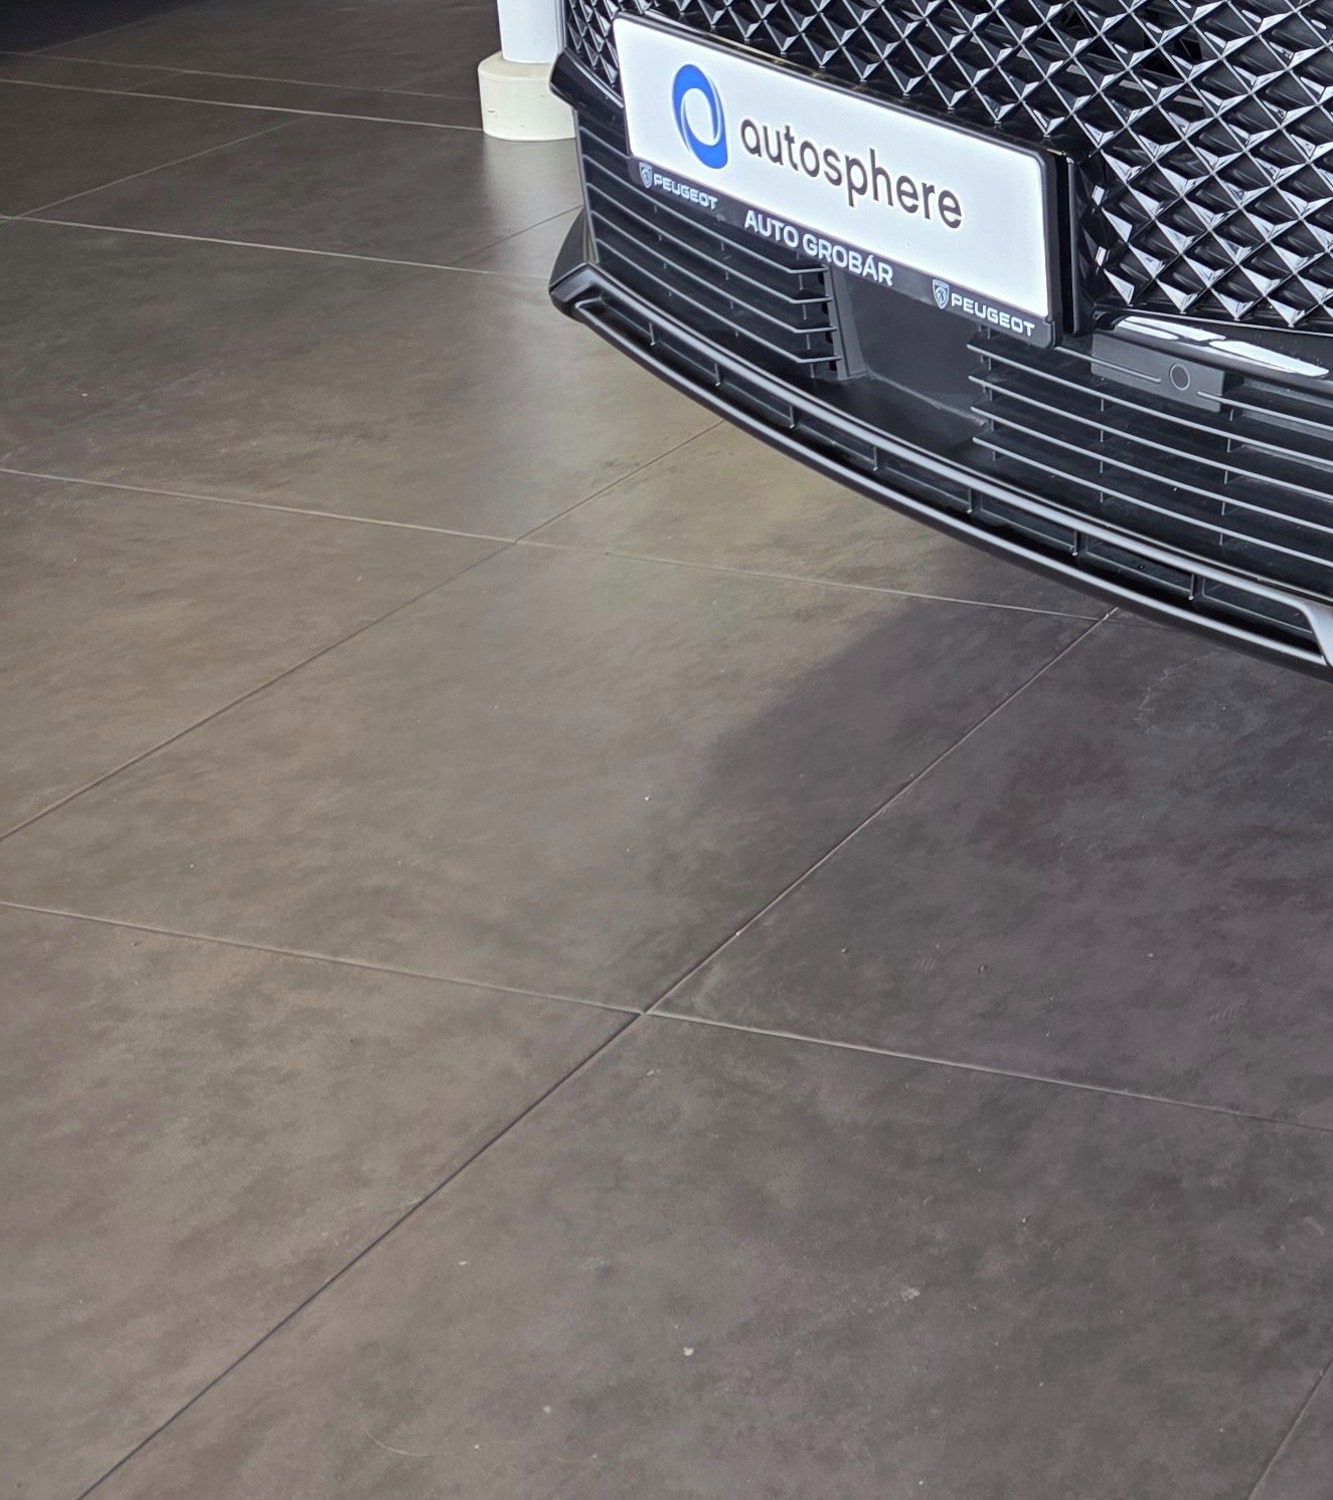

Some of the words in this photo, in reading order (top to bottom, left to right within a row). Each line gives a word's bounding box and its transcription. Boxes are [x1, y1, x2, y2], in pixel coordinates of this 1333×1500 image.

[653, 173, 719, 210] PEUGEOT
[741, 114, 964, 230] autosphere
[744, 209, 800, 248] AUTO
[802, 234, 894, 286] GROBÁR
[951, 292, 1036, 337] PEUGEOT
